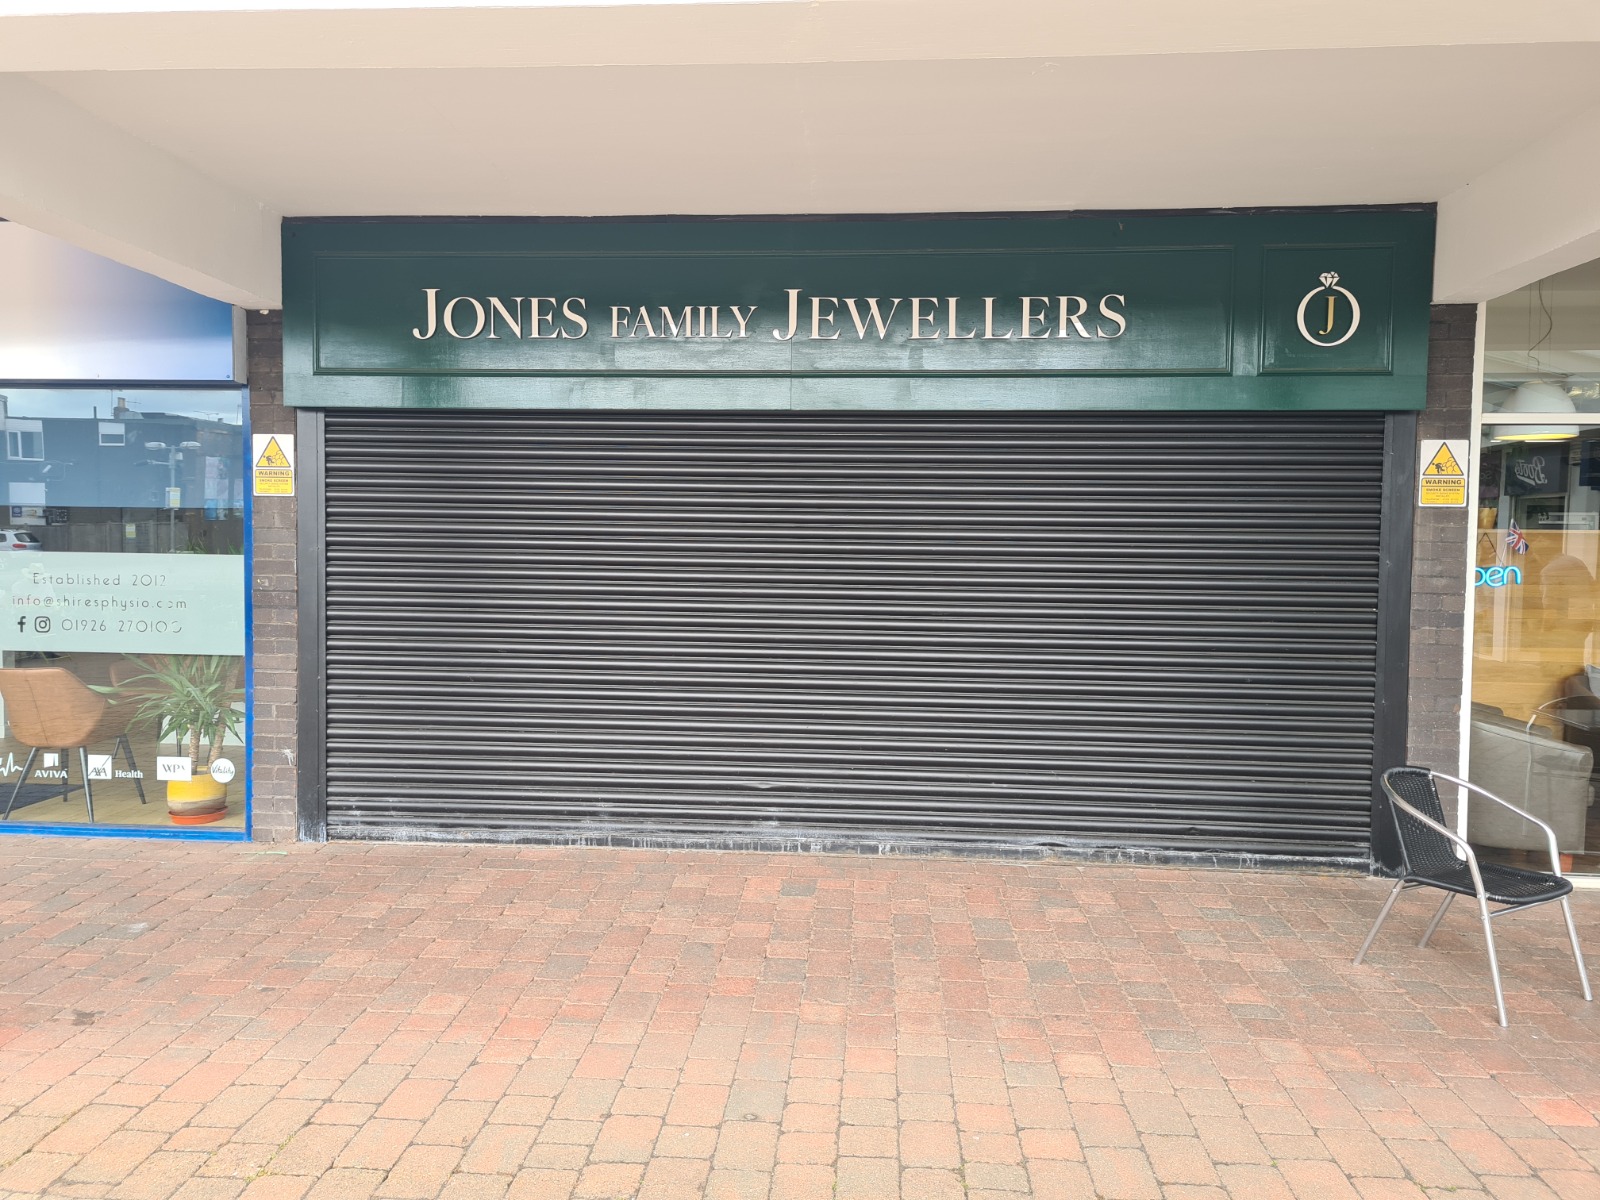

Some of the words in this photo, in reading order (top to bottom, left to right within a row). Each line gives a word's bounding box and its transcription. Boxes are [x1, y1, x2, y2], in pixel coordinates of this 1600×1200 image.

[412, 288, 589, 340] JONES
[609, 305, 758, 339] FAMILY
[772, 288, 1126, 340] JEWELLERS
[33, 573, 121, 586] Established
[61, 619, 107, 632] 01926
[34, 769, 68, 779] AVIVA
[115, 769, 144, 779] Health
